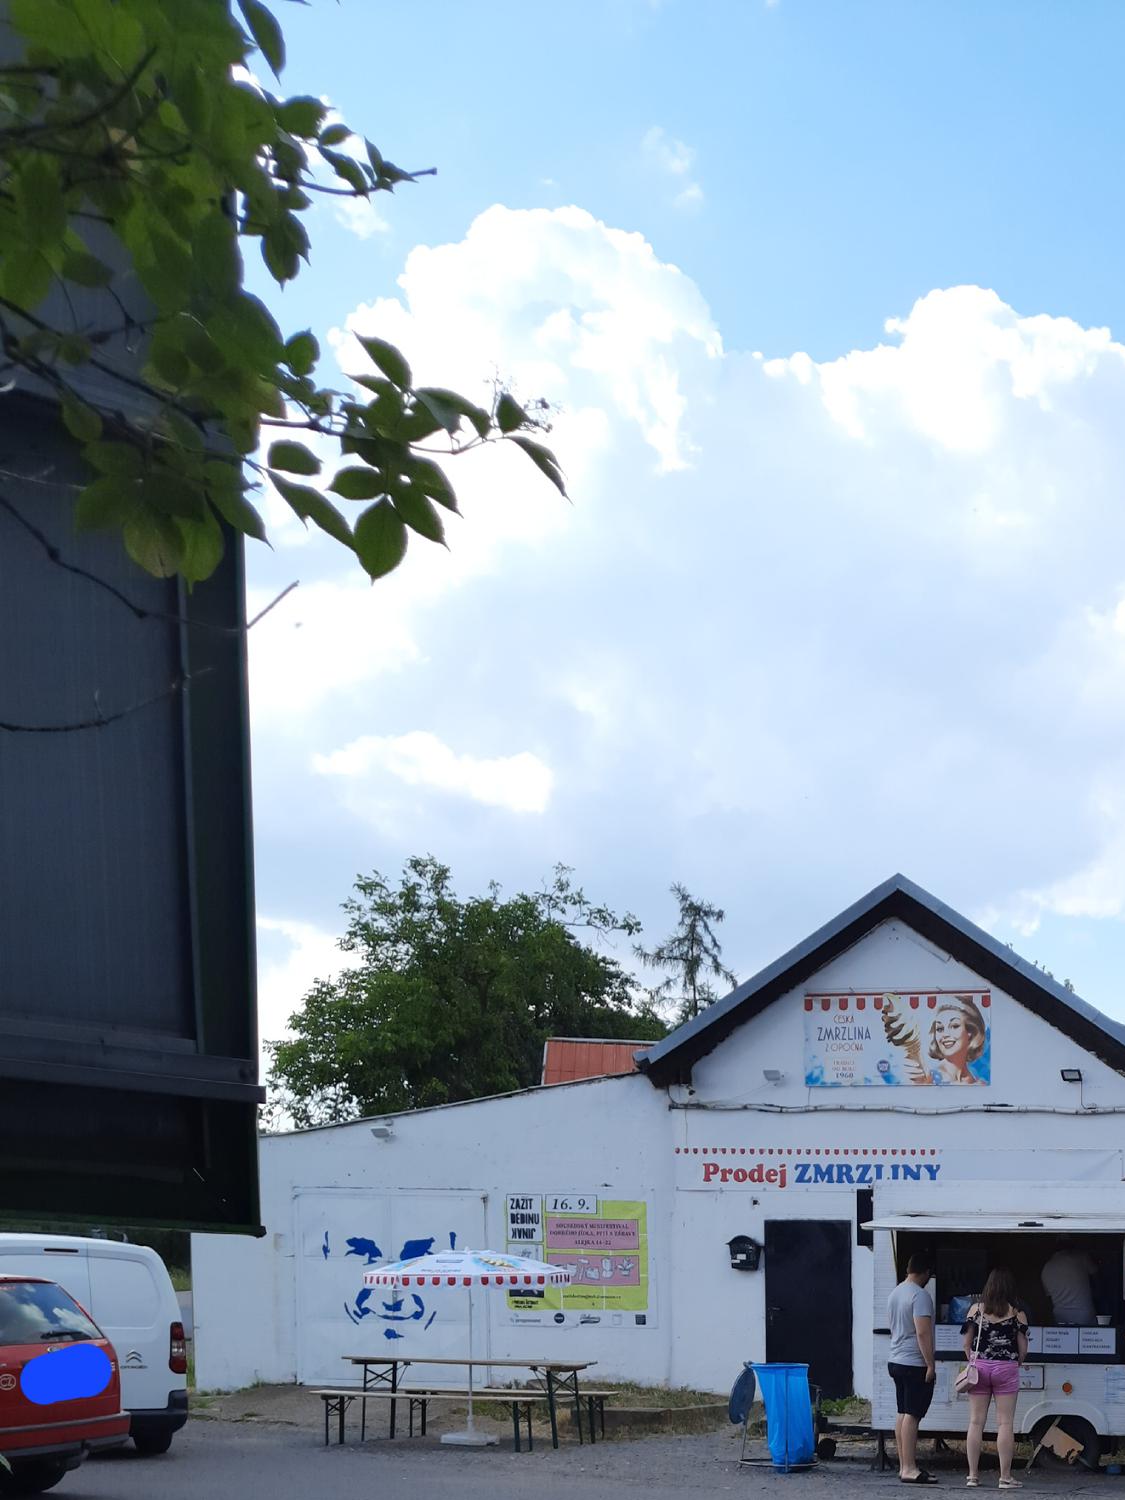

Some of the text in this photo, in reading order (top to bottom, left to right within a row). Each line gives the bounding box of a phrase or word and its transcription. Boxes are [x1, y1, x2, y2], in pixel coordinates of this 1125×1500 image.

[817, 1026, 871, 1041] ZMRZLINA
[702, 1163, 941, 1188] Prodej ZMRZLINY
[552, 1199, 590, 1210] 16. 9.
